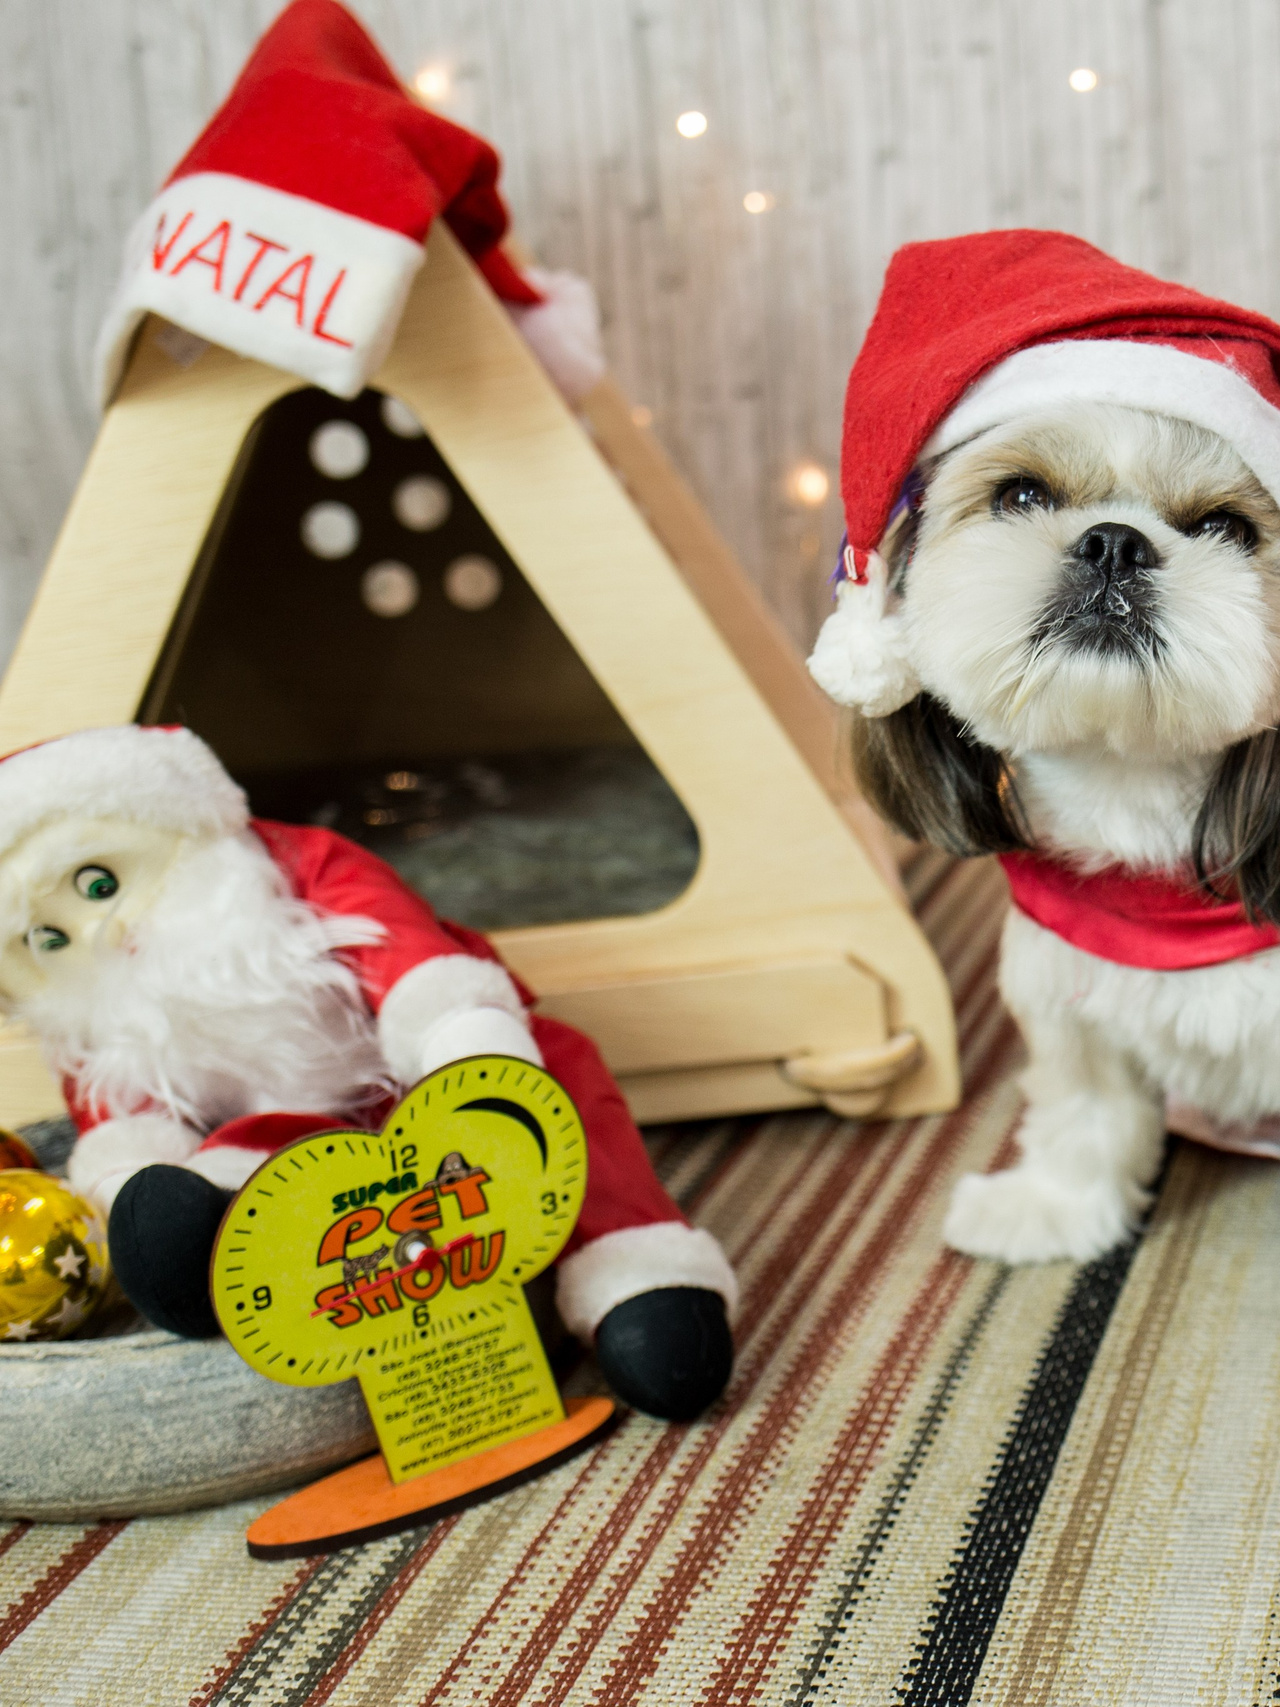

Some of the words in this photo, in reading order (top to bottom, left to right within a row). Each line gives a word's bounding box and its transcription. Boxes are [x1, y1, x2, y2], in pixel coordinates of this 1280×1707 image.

[390, 1144, 418, 1172] 12
[332, 1171, 418, 1214] SUPER
[540, 1192, 558, 1215] 3
[317, 1170, 493, 1267] PET
[314, 1230, 506, 1329] SHOW
[252, 1285, 273, 1311] 9
[412, 1304, 430, 1328] 6
